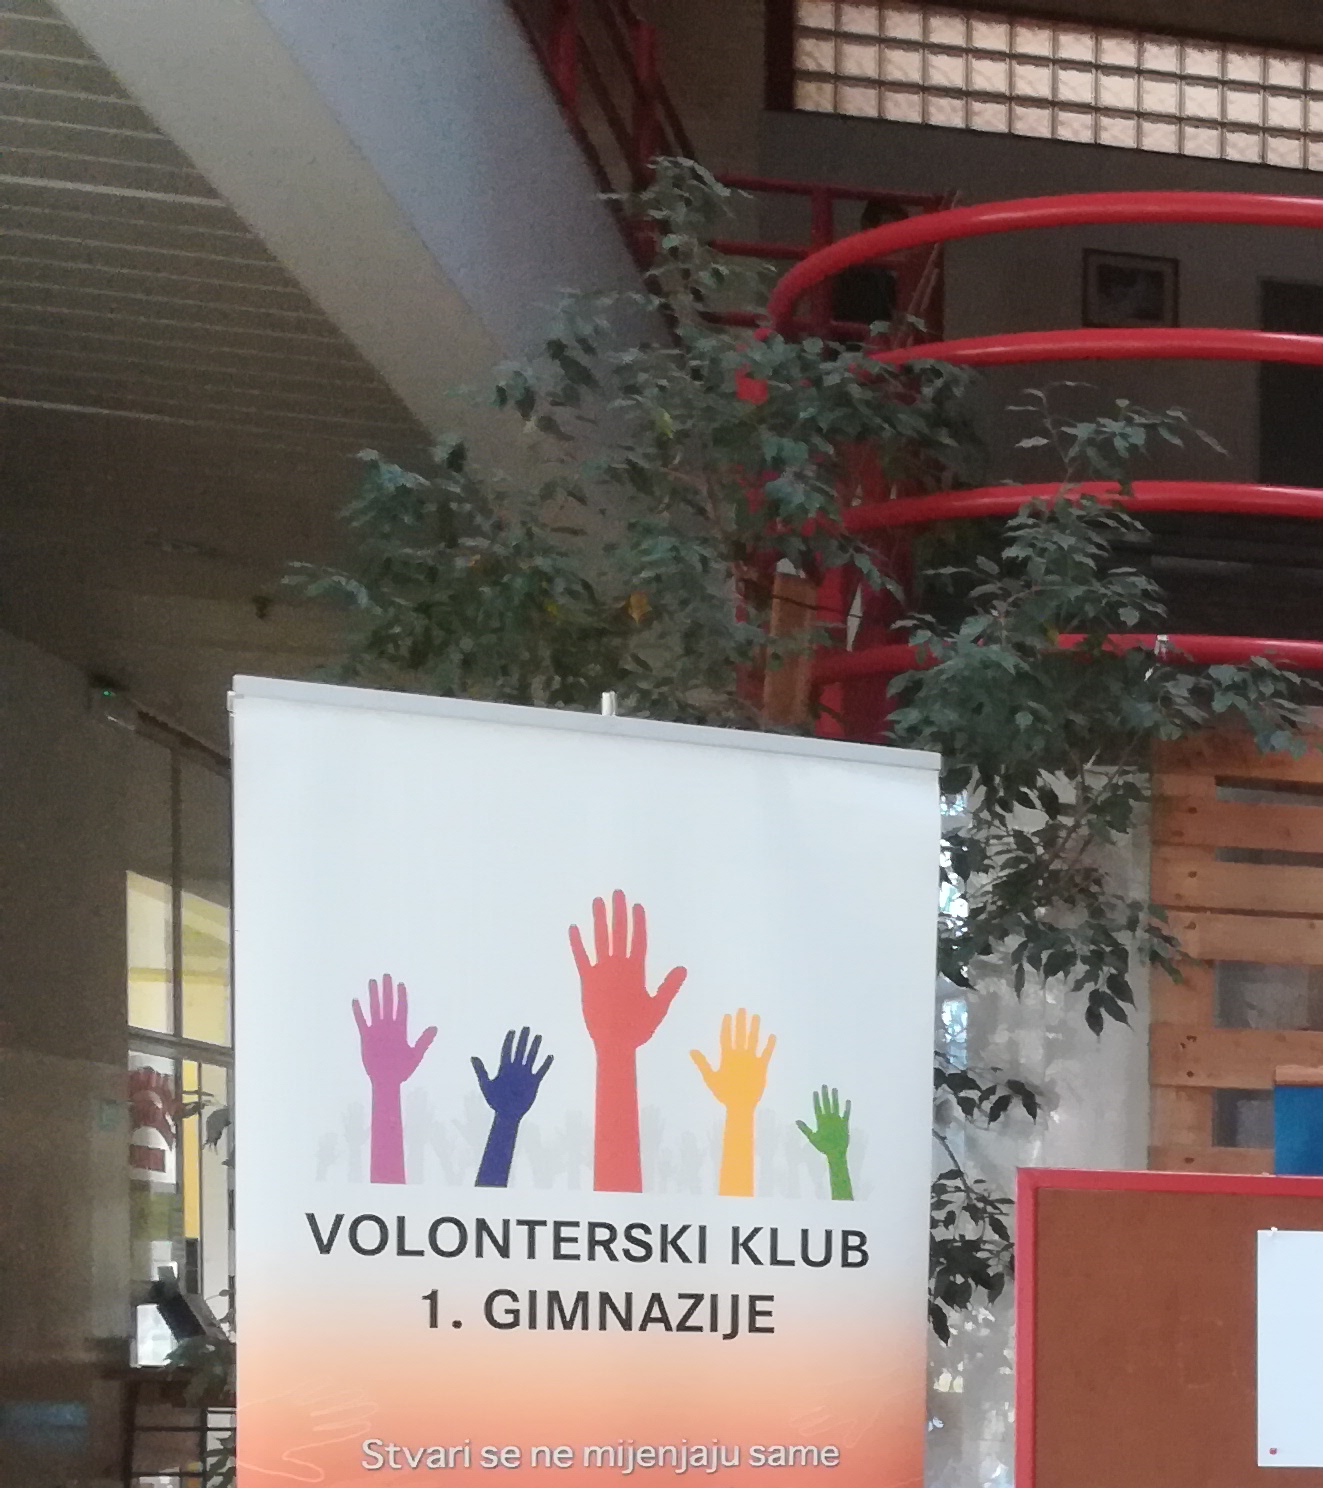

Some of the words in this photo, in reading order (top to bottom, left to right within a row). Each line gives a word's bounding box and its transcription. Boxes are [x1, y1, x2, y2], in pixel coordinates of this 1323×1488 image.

[305, 1212, 707, 1264] VOLONTERSKI
[731, 1225, 870, 1268] KLUB
[421, 1289, 462, 1329] 1.
[484, 1289, 775, 1340] GIMNAZIJE
[361, 1438, 471, 1470] Stvari
[480, 1445, 521, 1468] se
[531, 1445, 573, 1468] ne
[582, 1438, 741, 1474] mijenjaju
[749, 1444, 840, 1467] same
